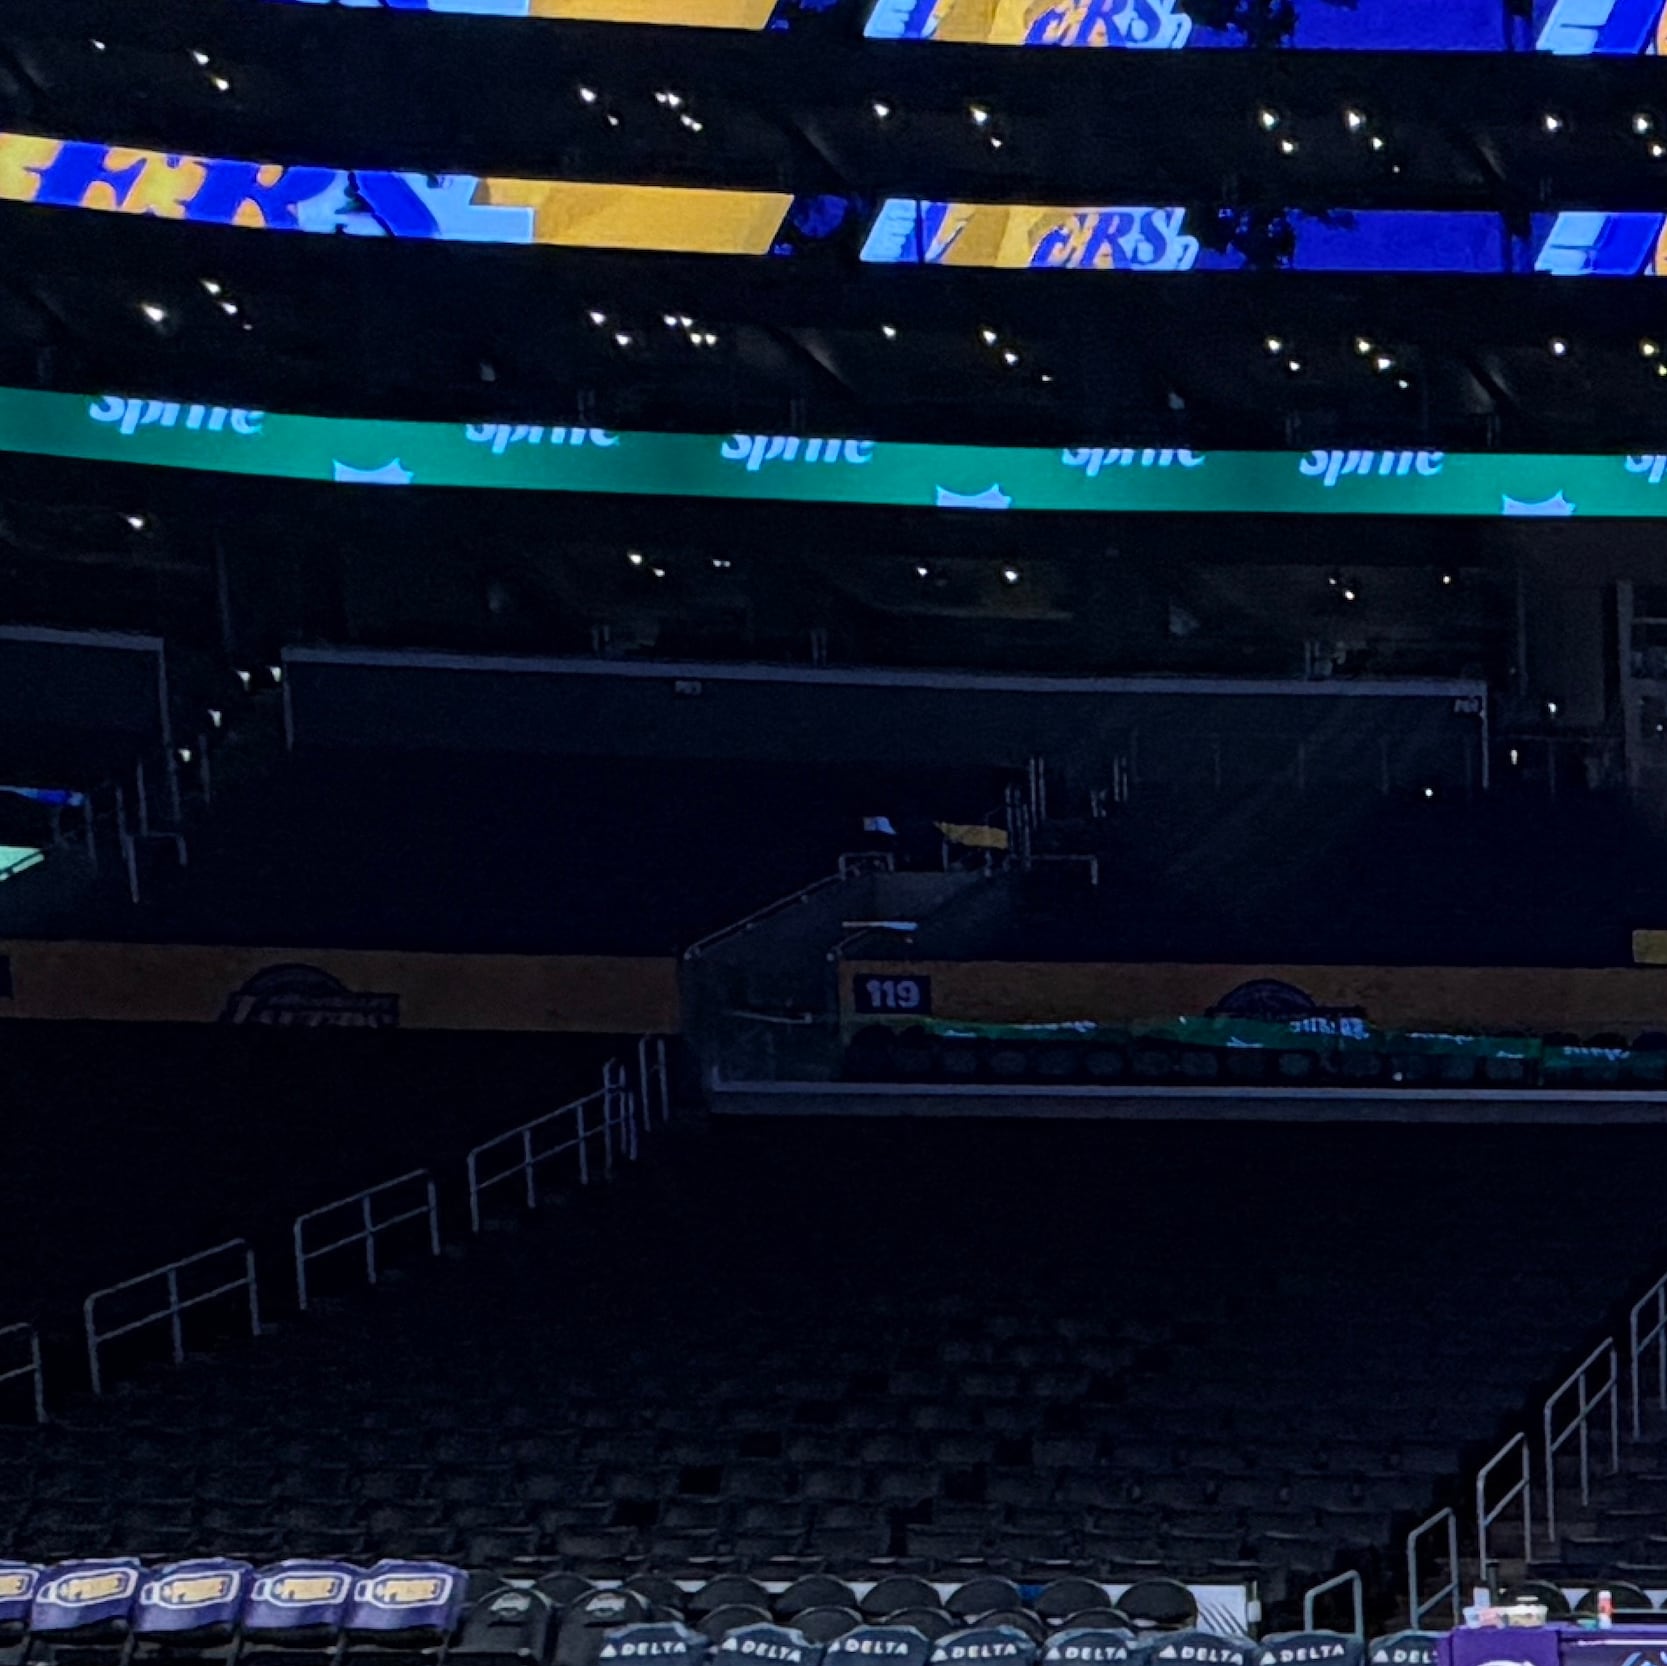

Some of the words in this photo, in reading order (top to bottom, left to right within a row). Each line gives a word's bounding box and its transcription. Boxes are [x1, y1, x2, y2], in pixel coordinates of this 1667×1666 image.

[866, 978, 921, 1009] 119
[621, 1641, 687, 1657] DELTA
[741, 1640, 802, 1663] DELTA
[845, 1638, 909, 1655] DELTA
[951, 1643, 1017, 1659] DELTA
[1065, 1646, 1128, 1661] DELTA
[1280, 1643, 1345, 1662] DELTA
[1181, 1645, 1244, 1666] DELTA
[1393, 1649, 1438, 1664] DEL
